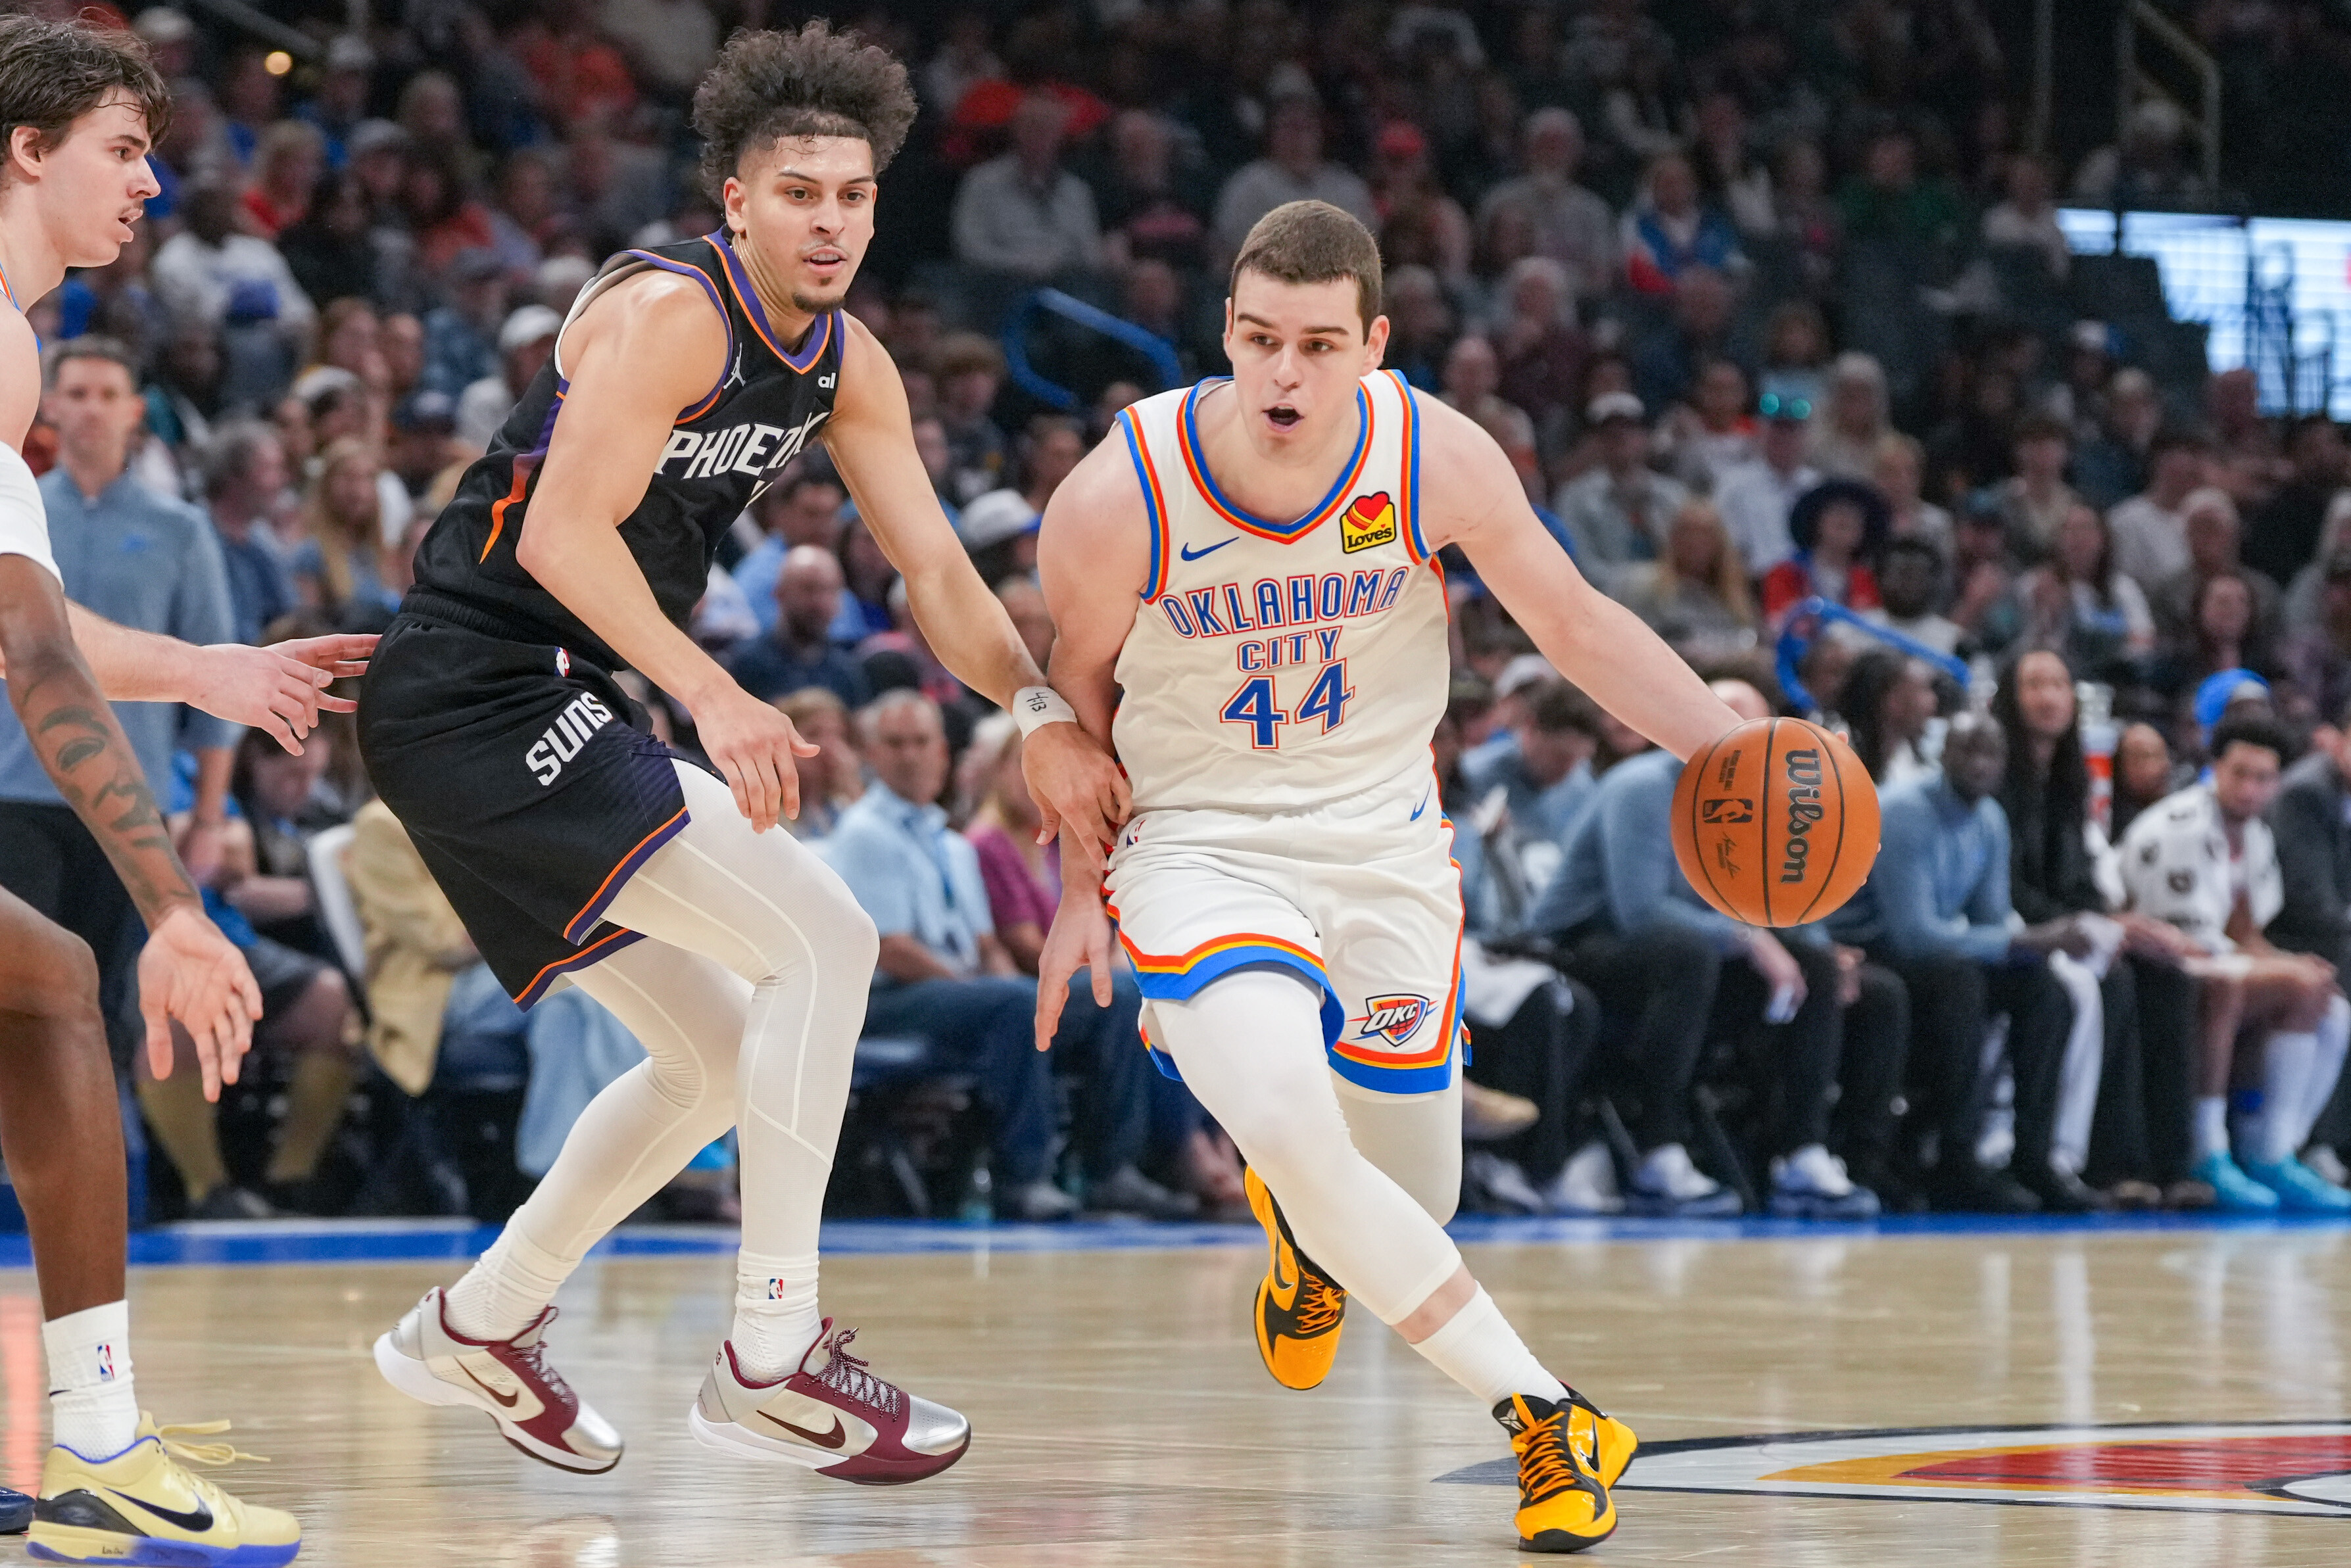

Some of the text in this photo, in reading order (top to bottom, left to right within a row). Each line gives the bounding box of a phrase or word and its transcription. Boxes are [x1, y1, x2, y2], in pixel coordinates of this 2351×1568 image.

[1159, 567, 1409, 639] OKLAHOMA
[1238, 625, 1343, 673] CITY
[525, 691, 614, 786] SUNS
[1219, 657, 1355, 749] 44
[1780, 748, 1824, 884] Wilson
[1361, 1003, 1419, 1033] OKC
